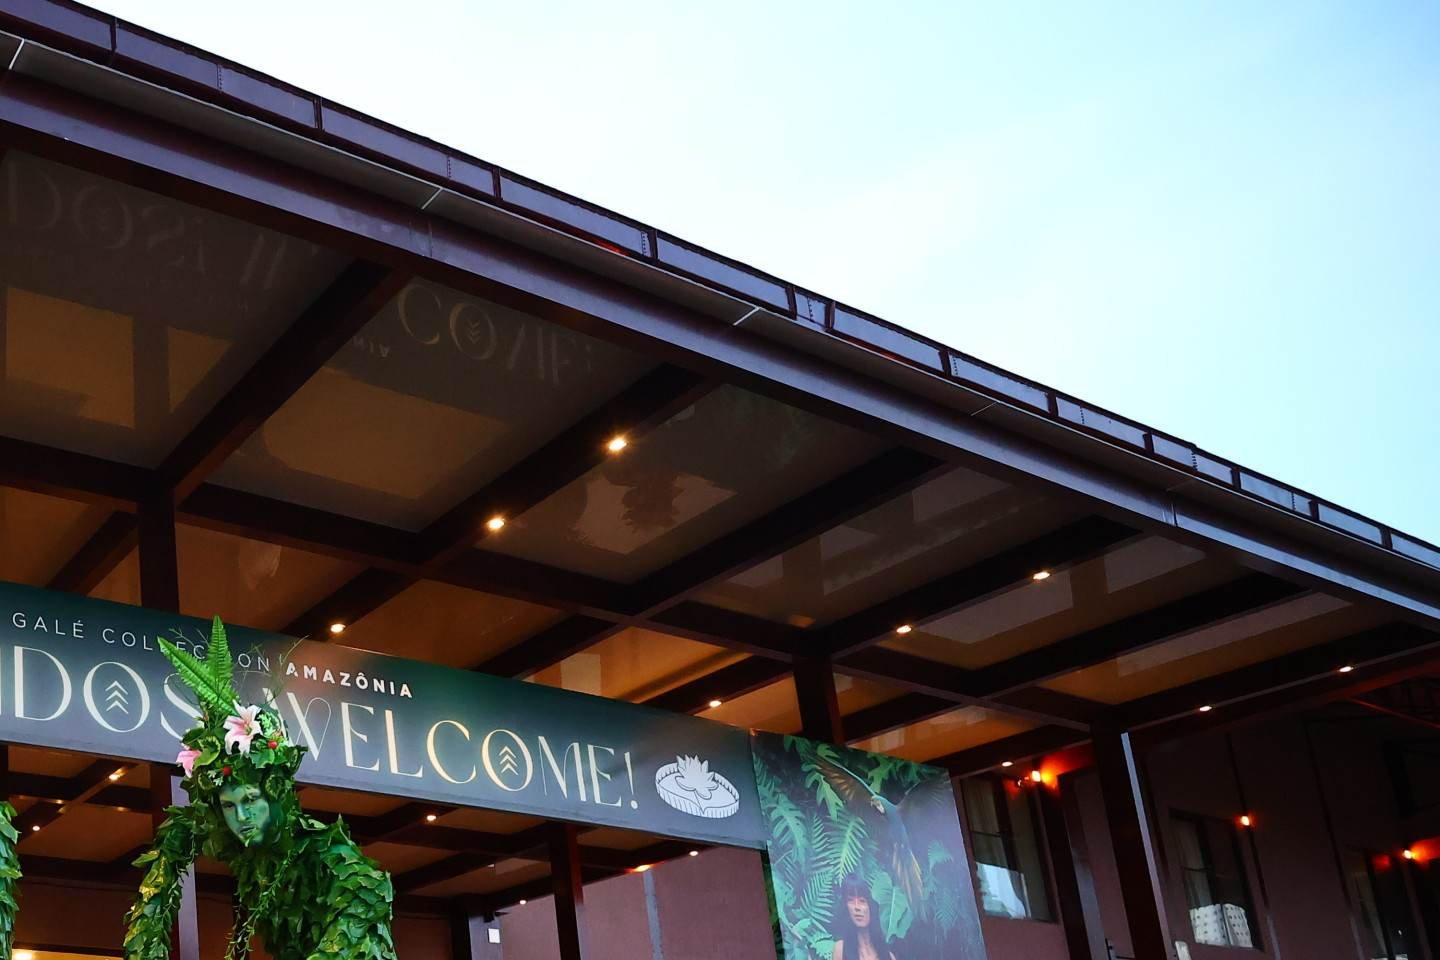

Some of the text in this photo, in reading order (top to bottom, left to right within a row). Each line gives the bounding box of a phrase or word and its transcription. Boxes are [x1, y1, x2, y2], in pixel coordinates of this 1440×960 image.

[12, 612, 84, 639] GALÉ
[102, 628, 270, 672] COLECON
[286, 662, 413, 699] AMAZÔNIA
[262, 687, 639, 810] WELCOME!
